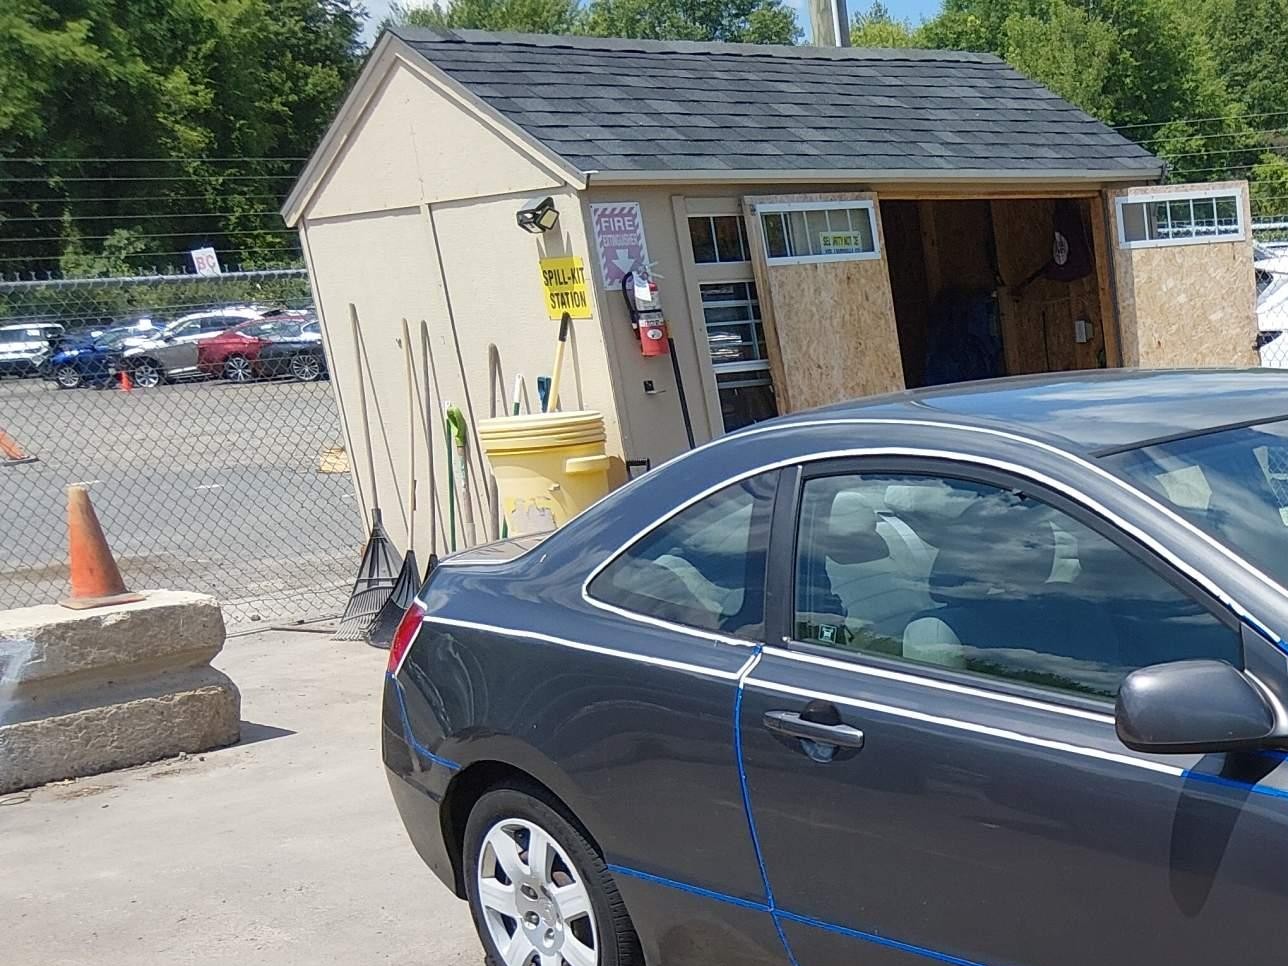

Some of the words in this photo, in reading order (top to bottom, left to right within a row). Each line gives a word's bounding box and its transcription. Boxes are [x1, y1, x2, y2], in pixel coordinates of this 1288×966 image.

[600, 216, 635, 231] FIRE
[542, 267, 585, 287] SPILL-KIT
[549, 291, 587, 309] STATION
